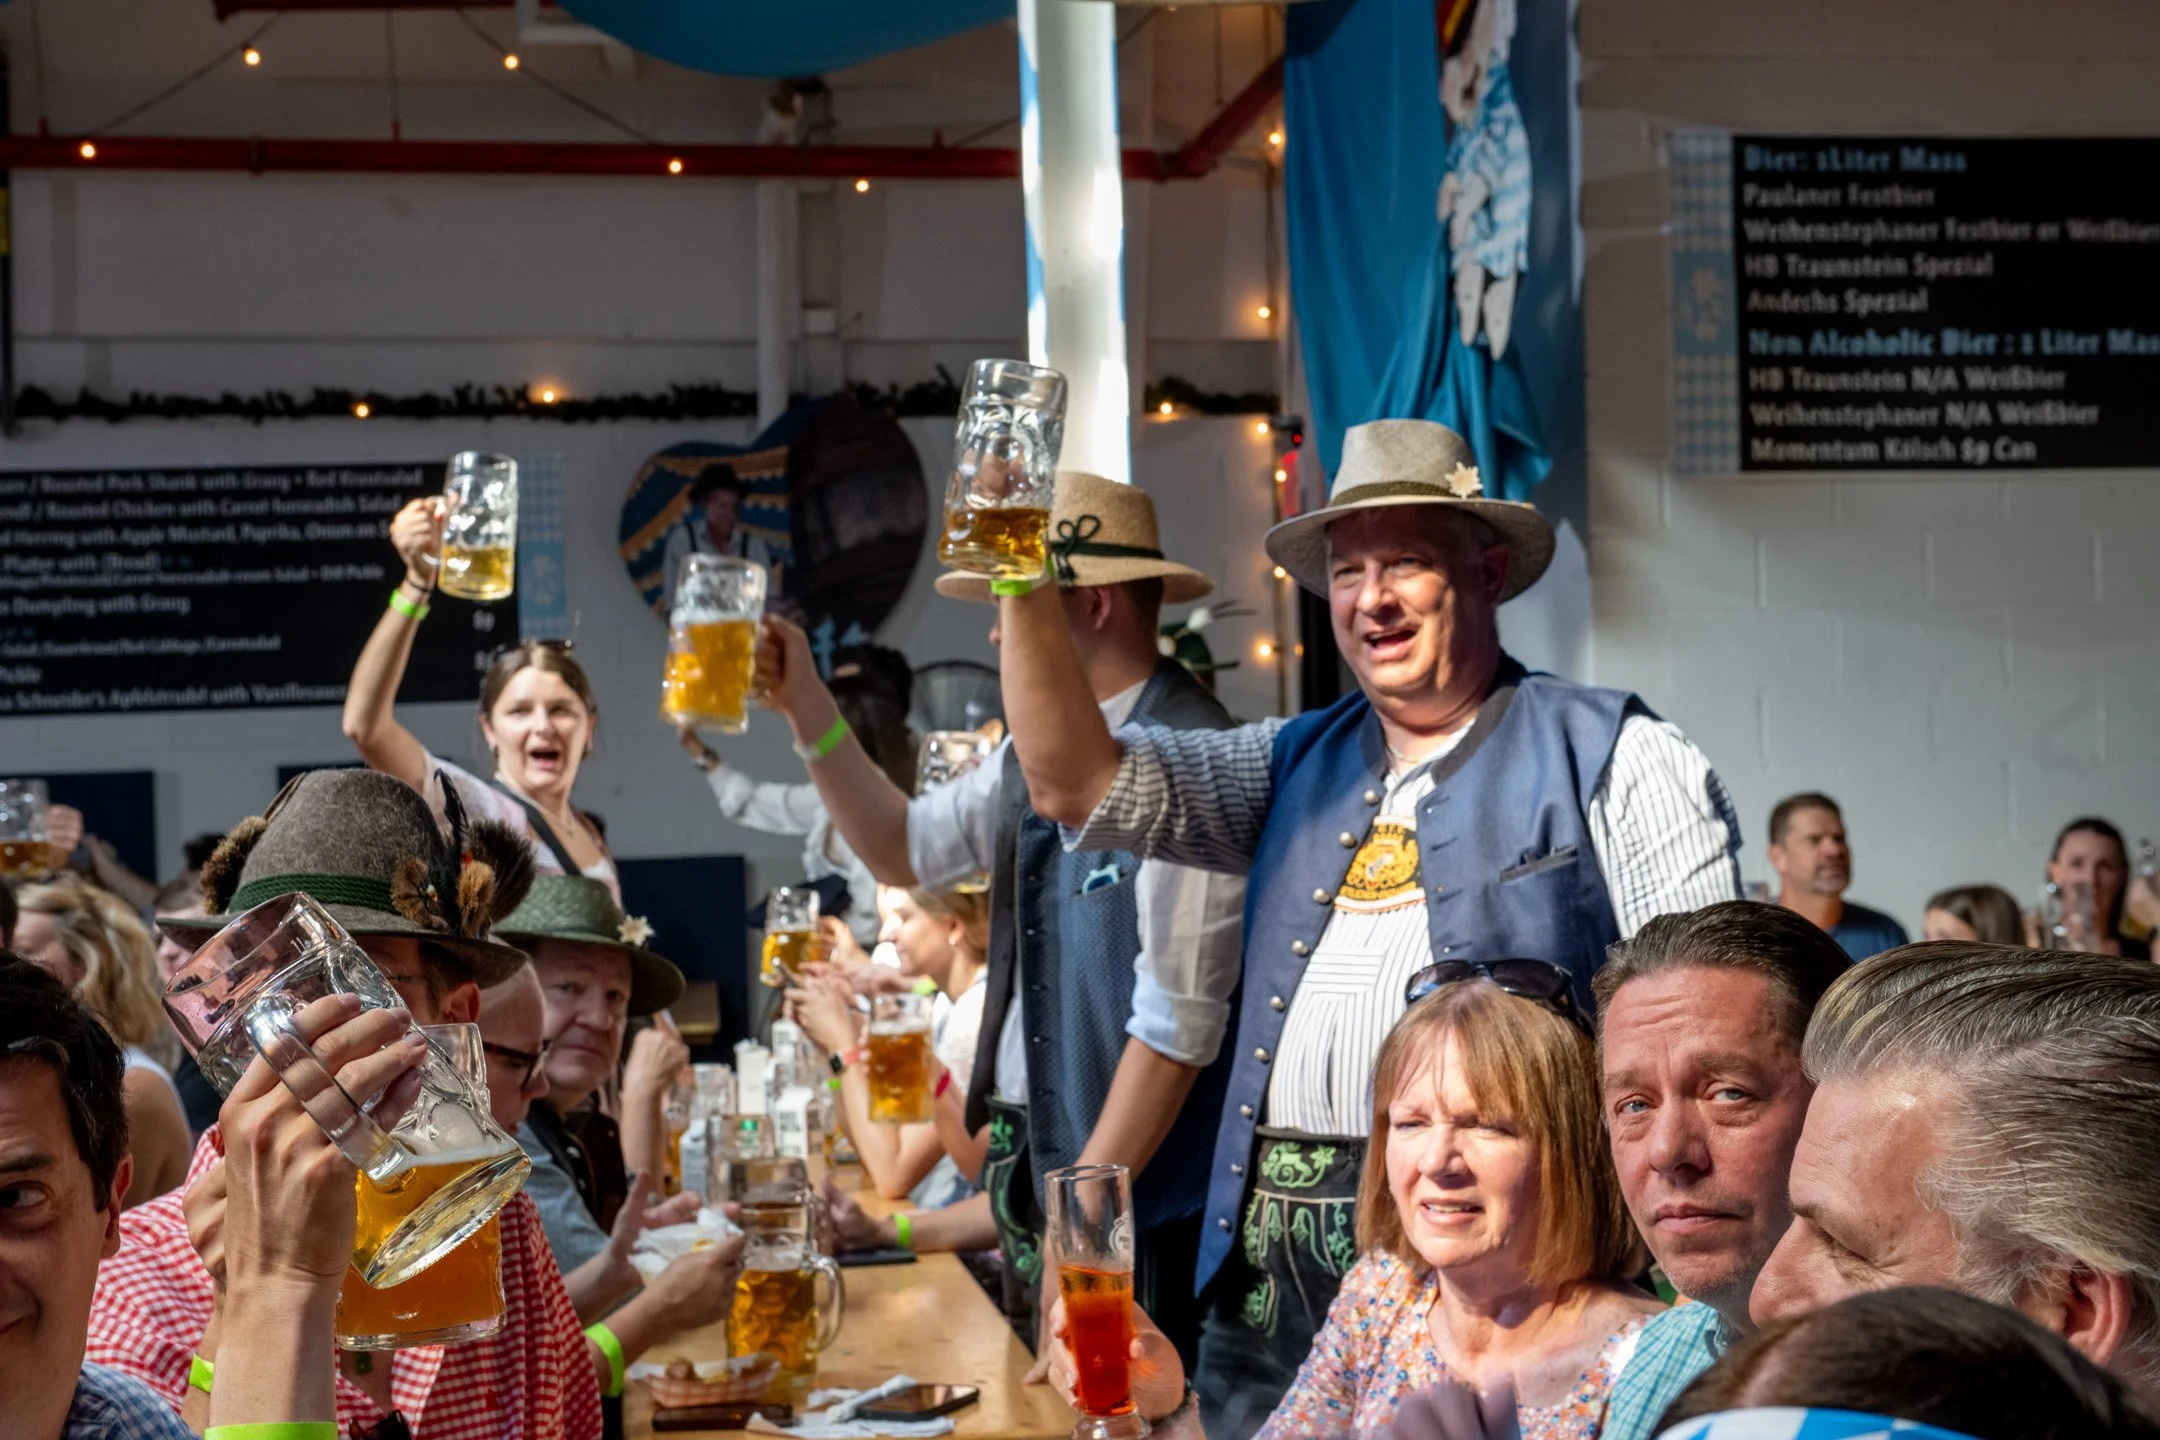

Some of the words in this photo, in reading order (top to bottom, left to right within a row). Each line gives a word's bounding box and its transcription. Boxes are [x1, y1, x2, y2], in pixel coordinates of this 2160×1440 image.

[1743, 144, 1810, 172] Bier:
[1898, 144, 1968, 173] Mass
[1742, 181, 1842, 208] Paulaner
[1847, 181, 1936, 208] Festbier
[1742, 216, 1940, 247] Weihenstephaner
[1945, 215, 2033, 243] Festbier
[2036, 221, 2061, 243] or
[1743, 252, 1779, 279] HB
[1784, 252, 1909, 279] Traunstein
[1912, 250, 1995, 282] Spezial
[1745, 288, 1841, 314] Andechs
[1843, 285, 1929, 319] Spezial
[1748, 327, 1804, 357] Non
[1809, 327, 1936, 357] Alcoholic
[2039, 327, 2101, 357] Liter
[2106, 326, 2160, 357] Mas
[1748, 366, 1785, 393] HB
[1789, 366, 1907, 393] Traunstein
[1911, 366, 1959, 395] N/A
[1749, 400, 1941, 432] Weihenstephaner
[1945, 400, 1993, 431] N/A
[1750, 435, 1880, 463] Momentum
[1993, 435, 2038, 462] Can
[201, 471, 239, 490] with
[178, 497, 217, 517] with
[79, 525, 117, 545] with
[58, 554, 98, 573] with
[100, 595, 136, 614] with
[211, 684, 249, 705] with
